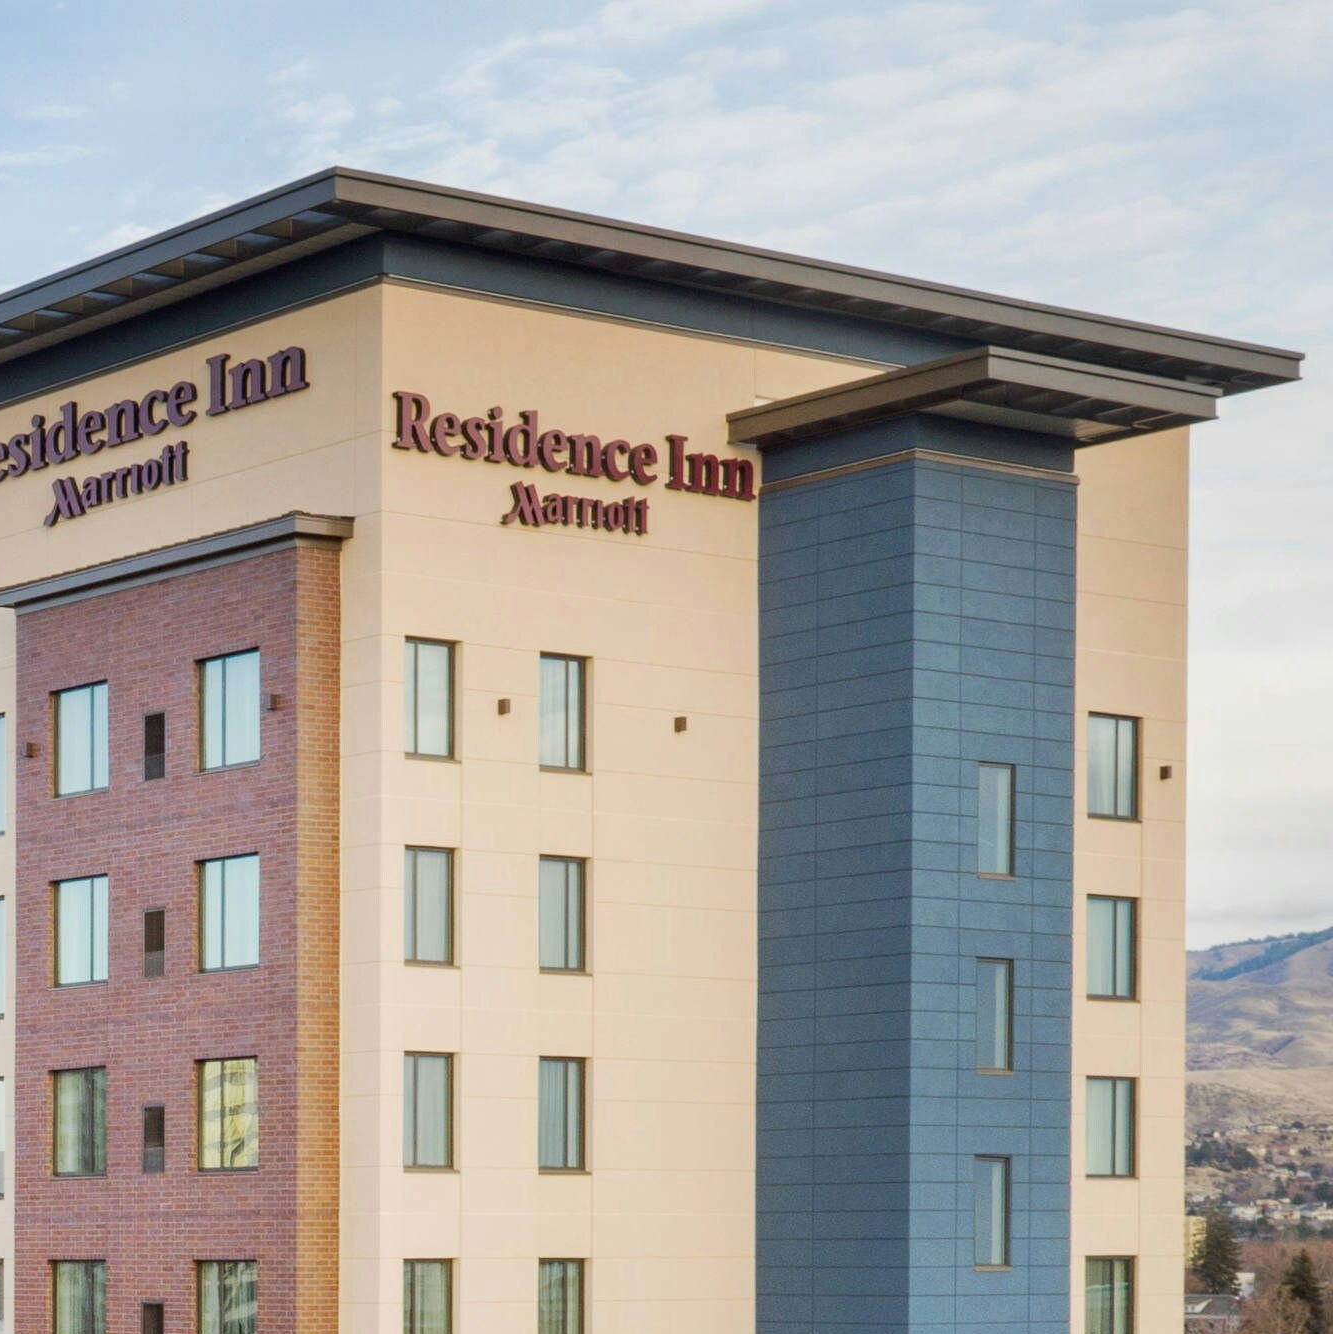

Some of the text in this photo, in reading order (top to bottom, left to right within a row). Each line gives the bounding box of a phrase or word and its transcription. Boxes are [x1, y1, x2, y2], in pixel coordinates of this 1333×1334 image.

[206, 346, 310, 417] Inn
[43, 440, 190, 527] Marriott
[392, 390, 757, 502] Residence Inn
[500, 480, 650, 535] Marriott
